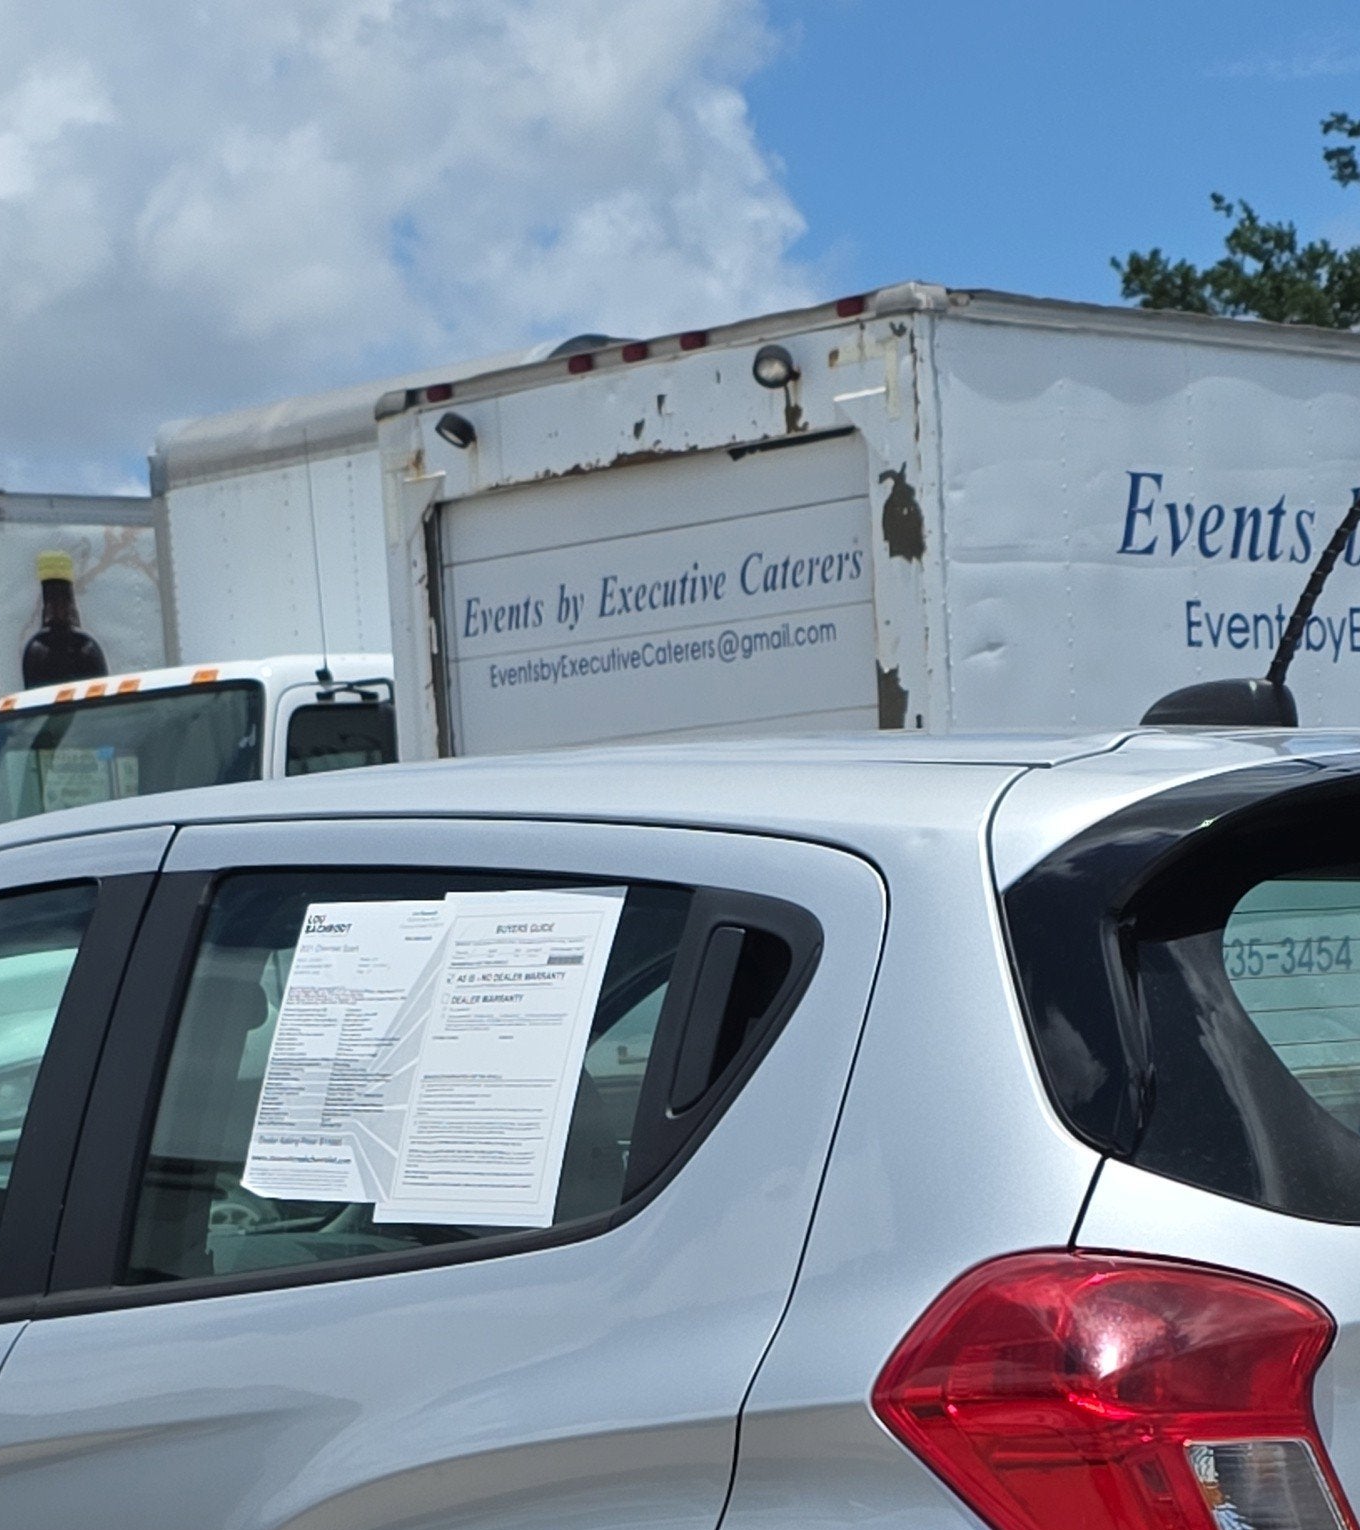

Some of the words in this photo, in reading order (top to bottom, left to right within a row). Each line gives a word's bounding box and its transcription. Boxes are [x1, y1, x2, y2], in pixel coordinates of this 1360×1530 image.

[1117, 470, 1316, 564] Events
[463, 595, 544, 638] Events
[557, 583, 585, 631] by
[598, 561, 727, 618] Executive
[740, 547, 864, 596] Caterers
[489, 621, 838, 688] EventsbyExecutiveCaterers@gmail.com
[1224, 936, 1353, 977] 35-3454
